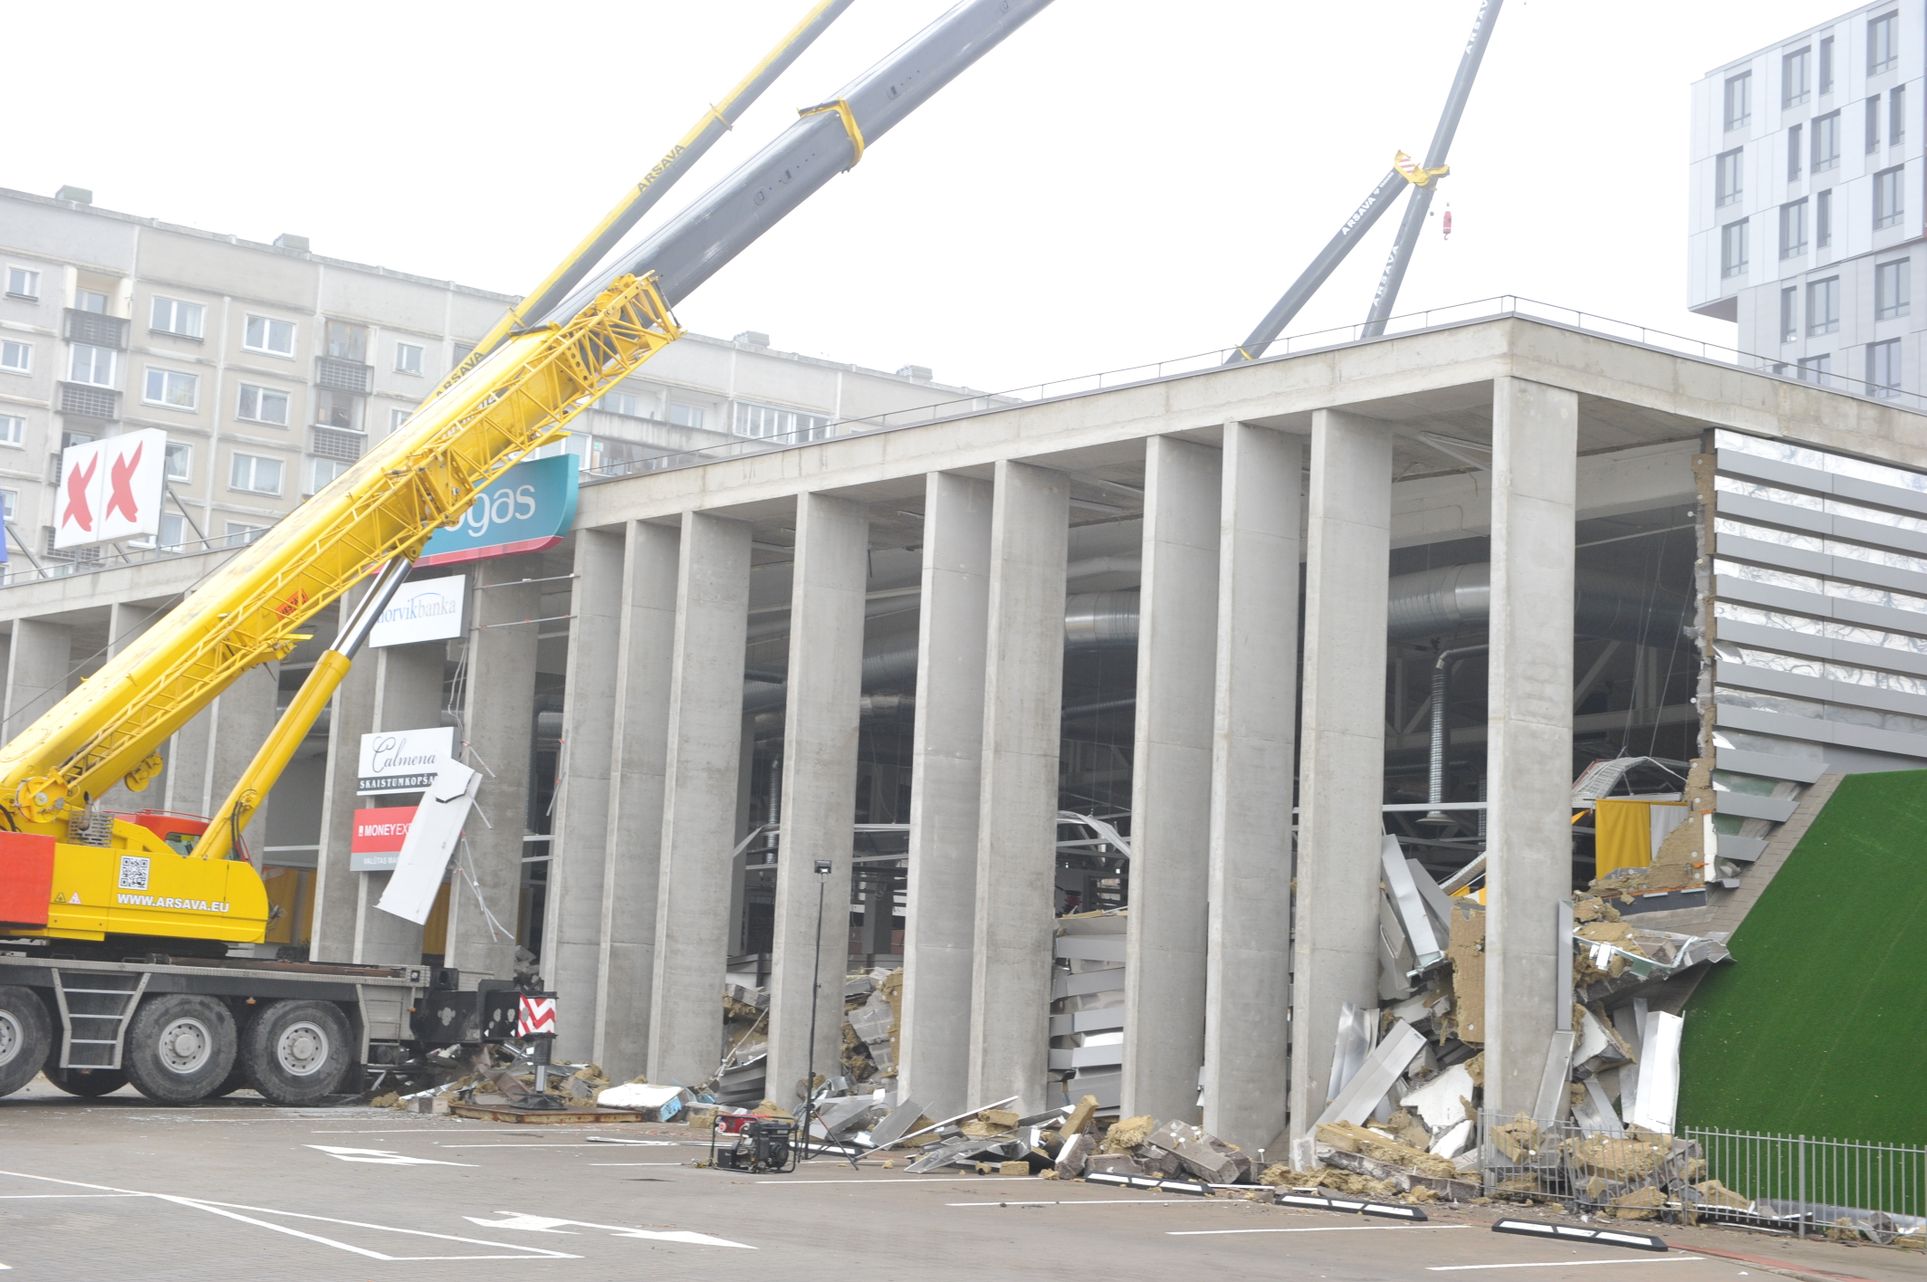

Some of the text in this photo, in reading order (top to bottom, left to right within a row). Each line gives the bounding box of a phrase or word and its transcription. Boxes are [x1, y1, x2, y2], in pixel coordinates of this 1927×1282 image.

[637, 144, 686, 193] ARSAVA
[1341, 196, 1377, 236] ARSAVA
[372, 736, 437, 773] Calmena
[359, 773, 437, 789] SKAISTUMKOPŠA
[117, 893, 230, 913] WWW.ARSAVA.EU
